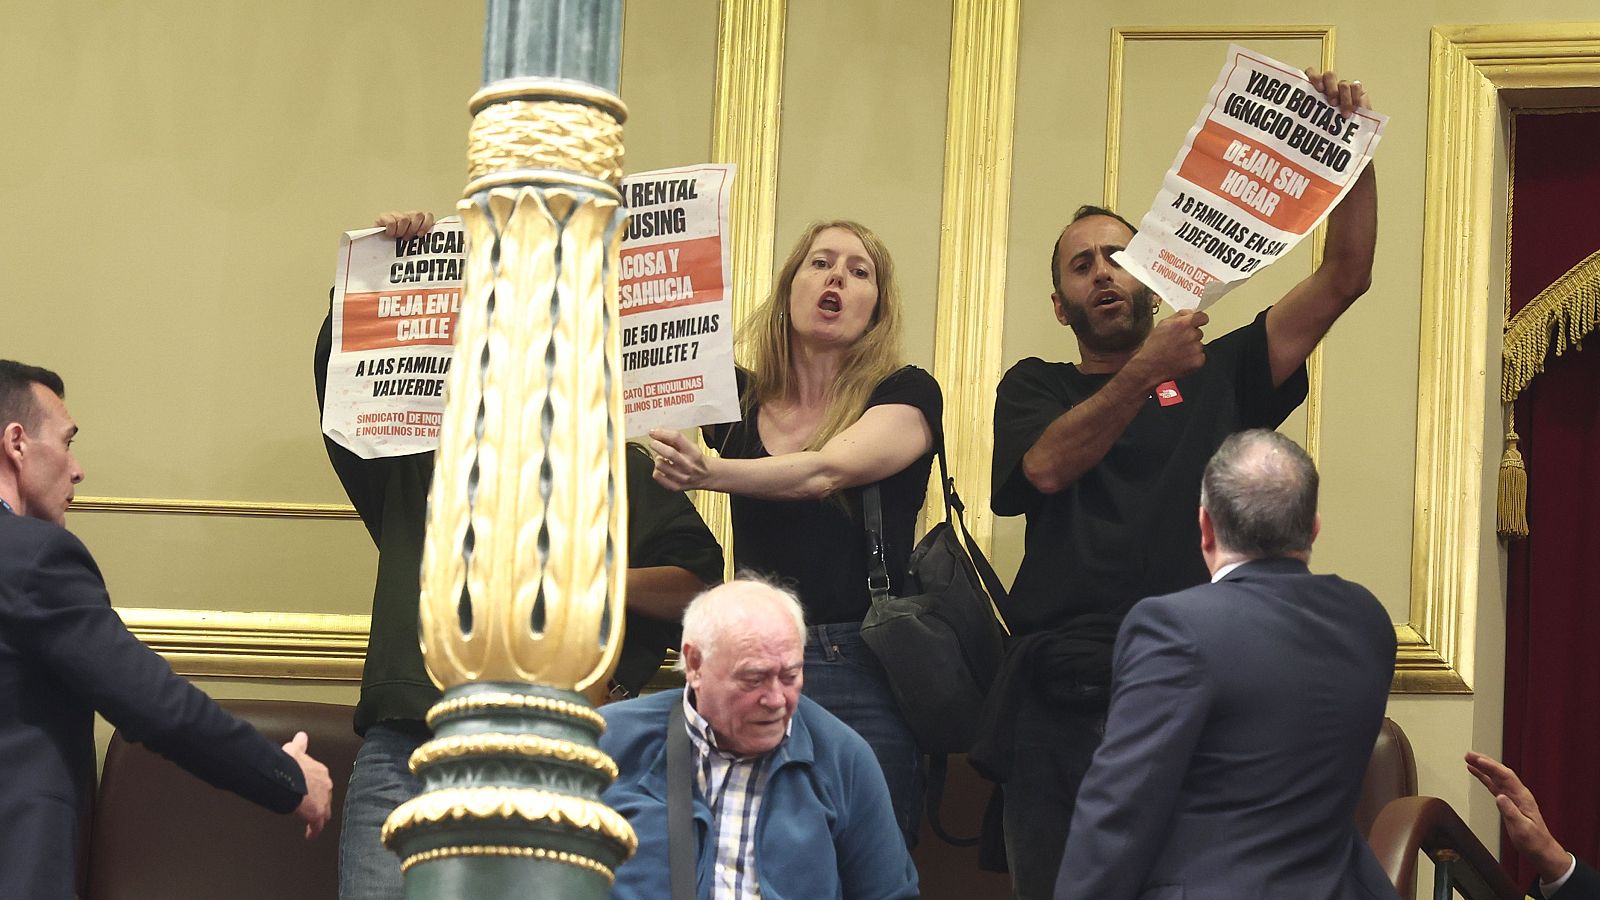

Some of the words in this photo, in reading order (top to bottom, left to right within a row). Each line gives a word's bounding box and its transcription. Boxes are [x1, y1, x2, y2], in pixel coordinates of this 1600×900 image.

[1245, 70, 1291, 105] YAGO
[1285, 88, 1346, 136] BOTAS
[1341, 122, 1359, 144] E
[1223, 93, 1294, 141] IGNACIO
[1287, 124, 1352, 173] BUENO
[1222, 139, 1280, 184] DEJAN
[1273, 166, 1310, 199] SIN
[632, 179, 698, 208] RENTAL
[1219, 169, 1281, 217] HOGAR
[1171, 192, 1185, 209] A
[1190, 201, 1250, 244] FAMILIAS
[1244, 232, 1270, 253] EN
[1263, 240, 1288, 256] SAN
[1174, 221, 1246, 269] ILDEFONSO
[668, 248, 679, 273] Y
[1158, 248, 1194, 275] SINDICATO
[1193, 268, 1207, 284] DE
[1151, 261, 1159, 271] E
[1156, 264, 1193, 292] INQUILINOS
[1192, 285, 1205, 298] DE
[378, 294, 423, 318] DEJA
[426, 293, 449, 315] EN
[397, 317, 450, 340] CALLE
[623, 326, 638, 347] DE
[640, 324, 658, 344] 50
[660, 314, 720, 341] FAMILIAS
[355, 360, 365, 377] A
[367, 357, 395, 376] LAS
[622, 343, 689, 371] TRIBULETE
[691, 341, 699, 360] 7
[373, 379, 444, 397] VALVERDE
[623, 388, 642, 400] CATO
[646, 385, 656, 396] DE
[657, 378, 702, 393] INQUILINAS
[653, 399, 663, 408] DE
[664, 393, 695, 407] MADRID
[356, 412, 405, 424] SINDICATO
[409, 413, 420, 423] DE
[356, 427, 361, 436] E
[362, 425, 412, 437] INQUILINOS
[415, 427, 426, 437] DE
